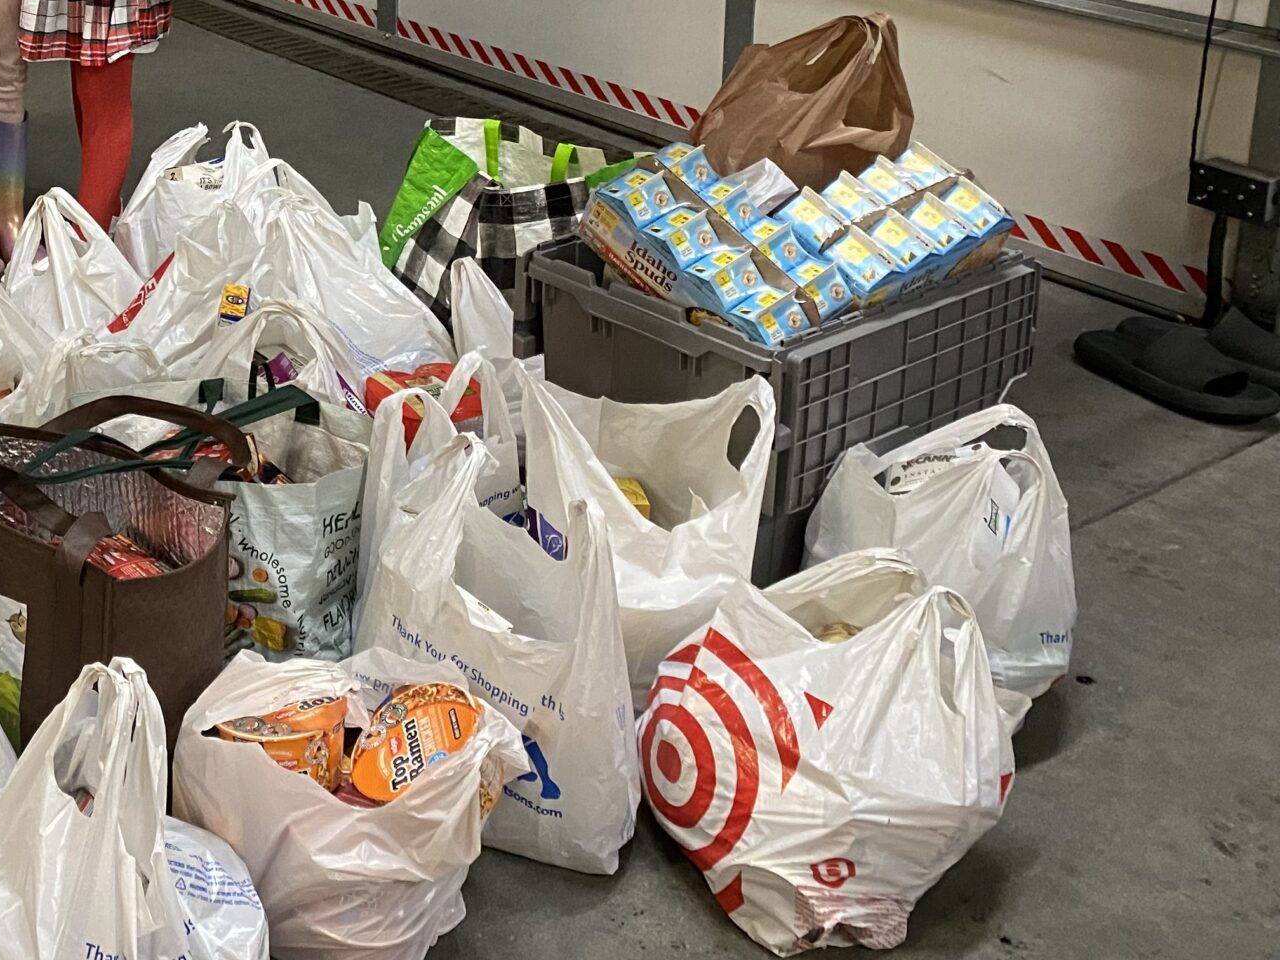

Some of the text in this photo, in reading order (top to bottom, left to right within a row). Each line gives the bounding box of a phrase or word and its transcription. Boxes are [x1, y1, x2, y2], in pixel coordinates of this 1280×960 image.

[624, 250, 674, 293] Spuds
[630, 240, 678, 282] Idaho
[391, 614, 422, 649] Thank
[424, 640, 447, 663] You
[470, 667, 529, 717] Shopping
[404, 718, 426, 782] Ramen
[391, 755, 410, 791] Top
